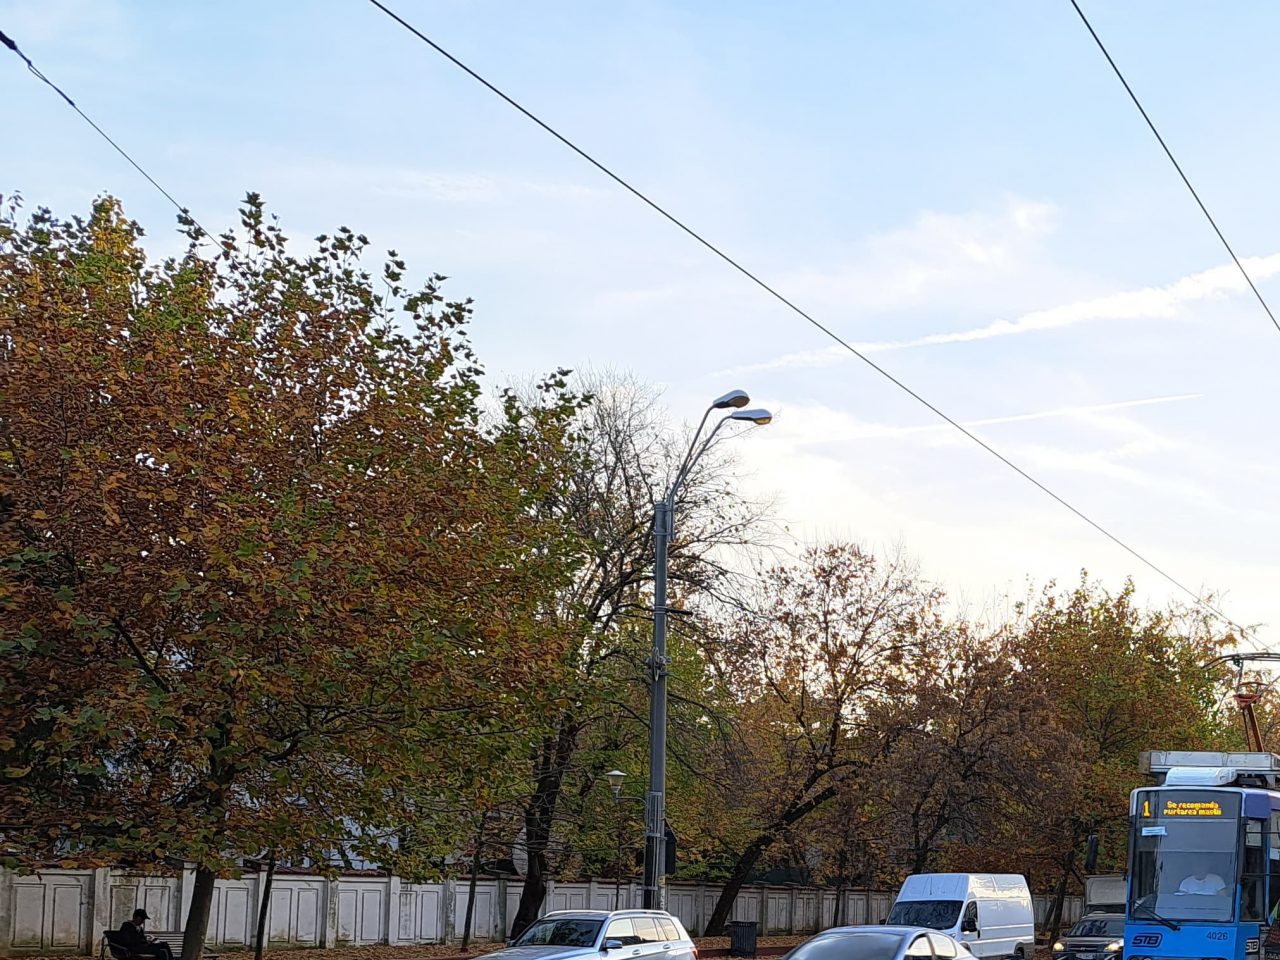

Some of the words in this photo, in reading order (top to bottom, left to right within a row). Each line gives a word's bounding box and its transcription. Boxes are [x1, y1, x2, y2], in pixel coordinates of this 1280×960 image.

[1143, 800, 1151, 817] 1
[1132, 934, 1160, 945] STB
[1206, 931, 1229, 940] 4026
